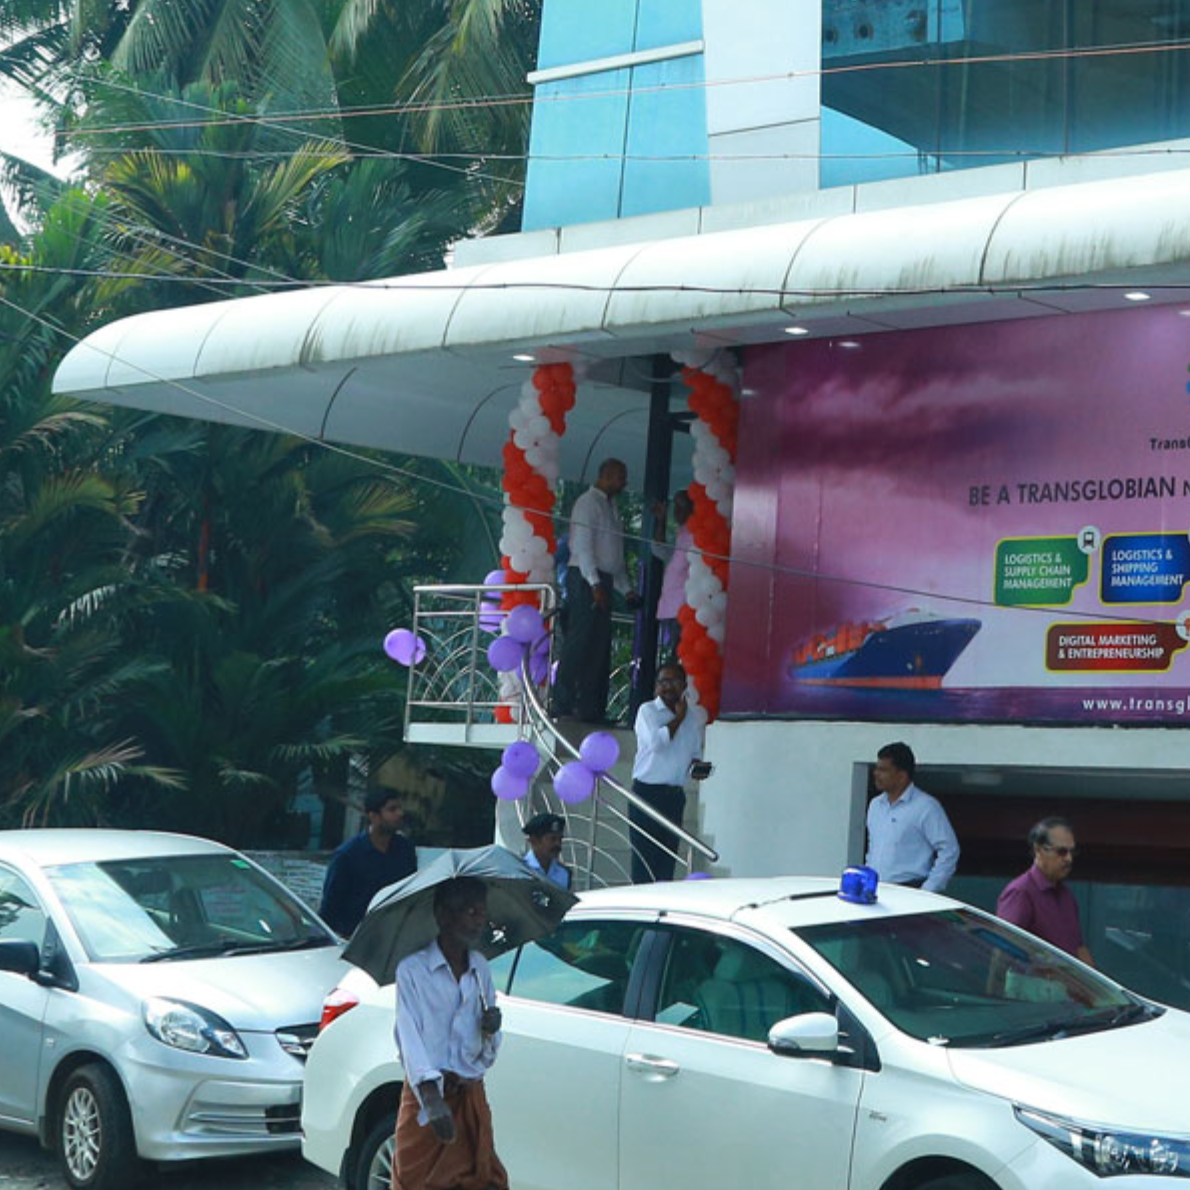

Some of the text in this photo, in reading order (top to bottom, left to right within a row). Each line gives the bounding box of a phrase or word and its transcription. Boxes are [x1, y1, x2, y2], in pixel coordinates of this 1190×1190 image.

[968, 485, 991, 507] BE
[996, 485, 1011, 505] A
[1017, 476, 1177, 505] TRANSGLOBIAN
[1003, 552, 1063, 565] LOGISTICS &
[1111, 548, 1174, 562] LOGISTICS &
[1003, 564, 1072, 578] SUPPLY CHAIN
[1111, 561, 1159, 575] SHIPPING
[1003, 577, 1073, 590] MANAGEMENT
[1110, 574, 1185, 587] MANAGEMENT
[1058, 633, 1158, 647] DIGITAL MARKETING
[1057, 646, 1166, 660] & ENTREPRENEURSHIP
